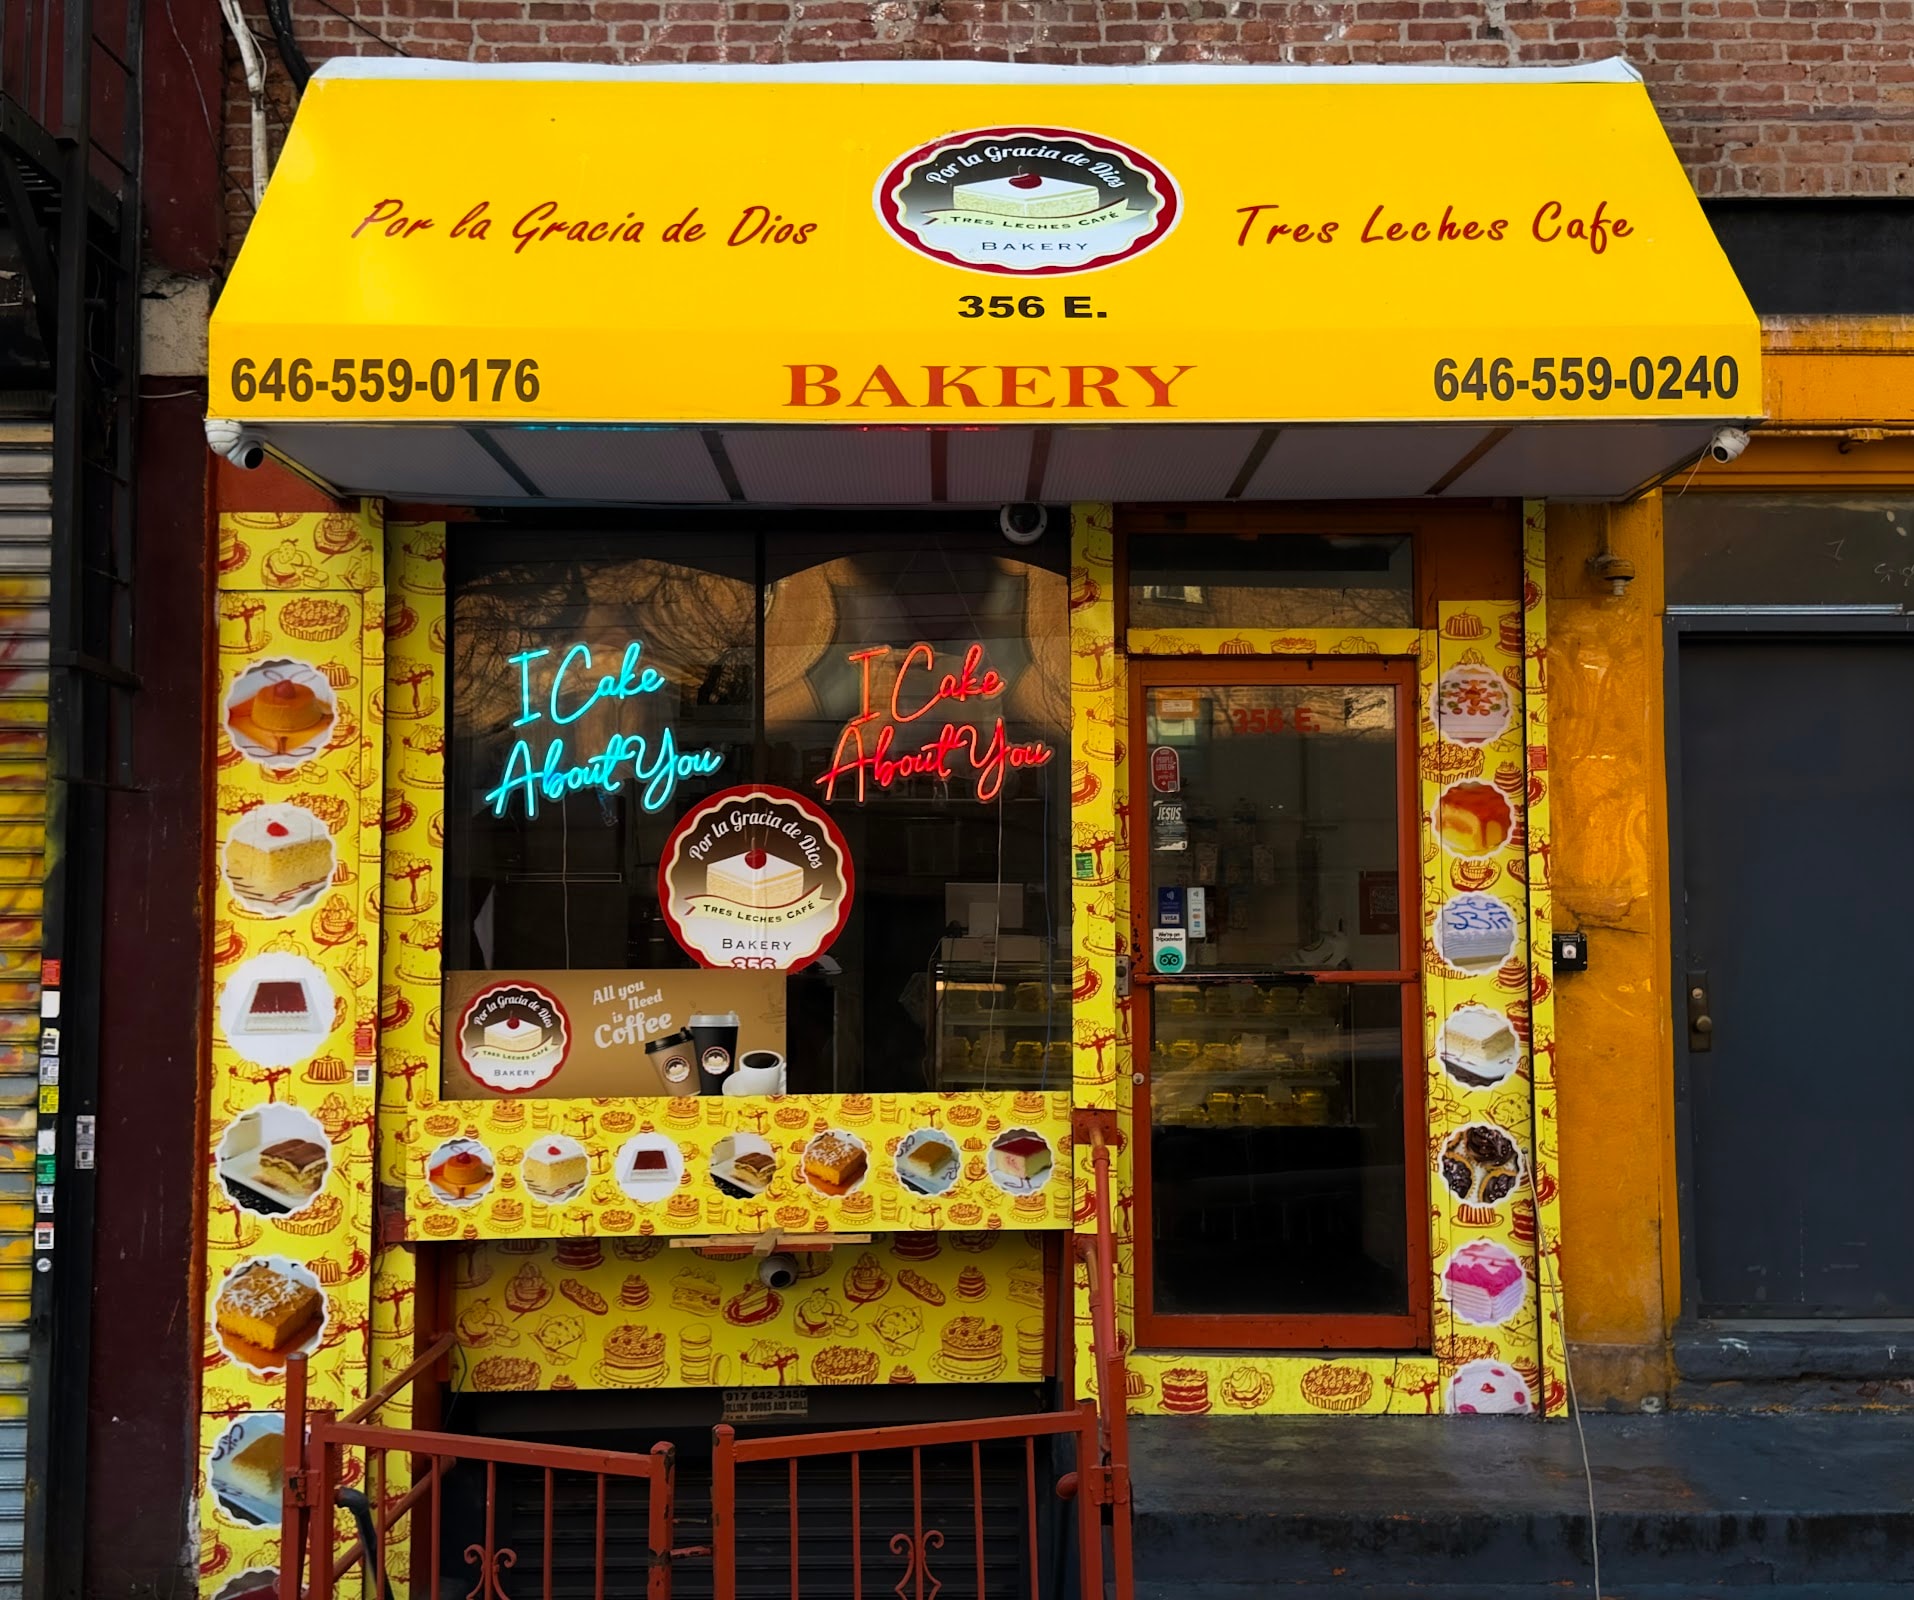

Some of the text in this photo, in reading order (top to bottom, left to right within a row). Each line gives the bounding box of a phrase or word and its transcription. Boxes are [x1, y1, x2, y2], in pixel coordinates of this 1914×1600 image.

[926, 145, 1126, 188] Por la Gracia de Dios
[351, 198, 818, 254] Por la Gracia de Dios
[951, 215, 994, 226] TRES
[1002, 220, 1072, 230] LECHES
[1235, 200, 1635, 255] Tres Leches Cafe
[982, 241, 1089, 251] BAKERY
[957, 295, 1108, 319] 356 E.
[231, 357, 541, 403] 646-559-0176
[782, 364, 1198, 408] BAKERY
[1434, 355, 1739, 401] 646-559-0240
[508, 640, 666, 728] I Cake
[848, 641, 1005, 727] I Cake
[1232, 708, 1321, 734] 356 E.
[484, 725, 725, 818] About You
[814, 716, 1054, 804] About You
[1157, 807, 1182, 820] JESUS
[688, 810, 824, 869] Por la Gracia de Dios
[703, 904, 733, 917] TRES
[737, 911, 783, 923] LECHES
[722, 938, 792, 951] BAKERY
[473, 994, 553, 1028] Por la Gracia de Dios
[593, 980, 646, 1006] All you
[594, 1011, 673, 1048] Coffee
[612, 1011, 624, 1023] is
[494, 1069, 536, 1077] BAKERY
